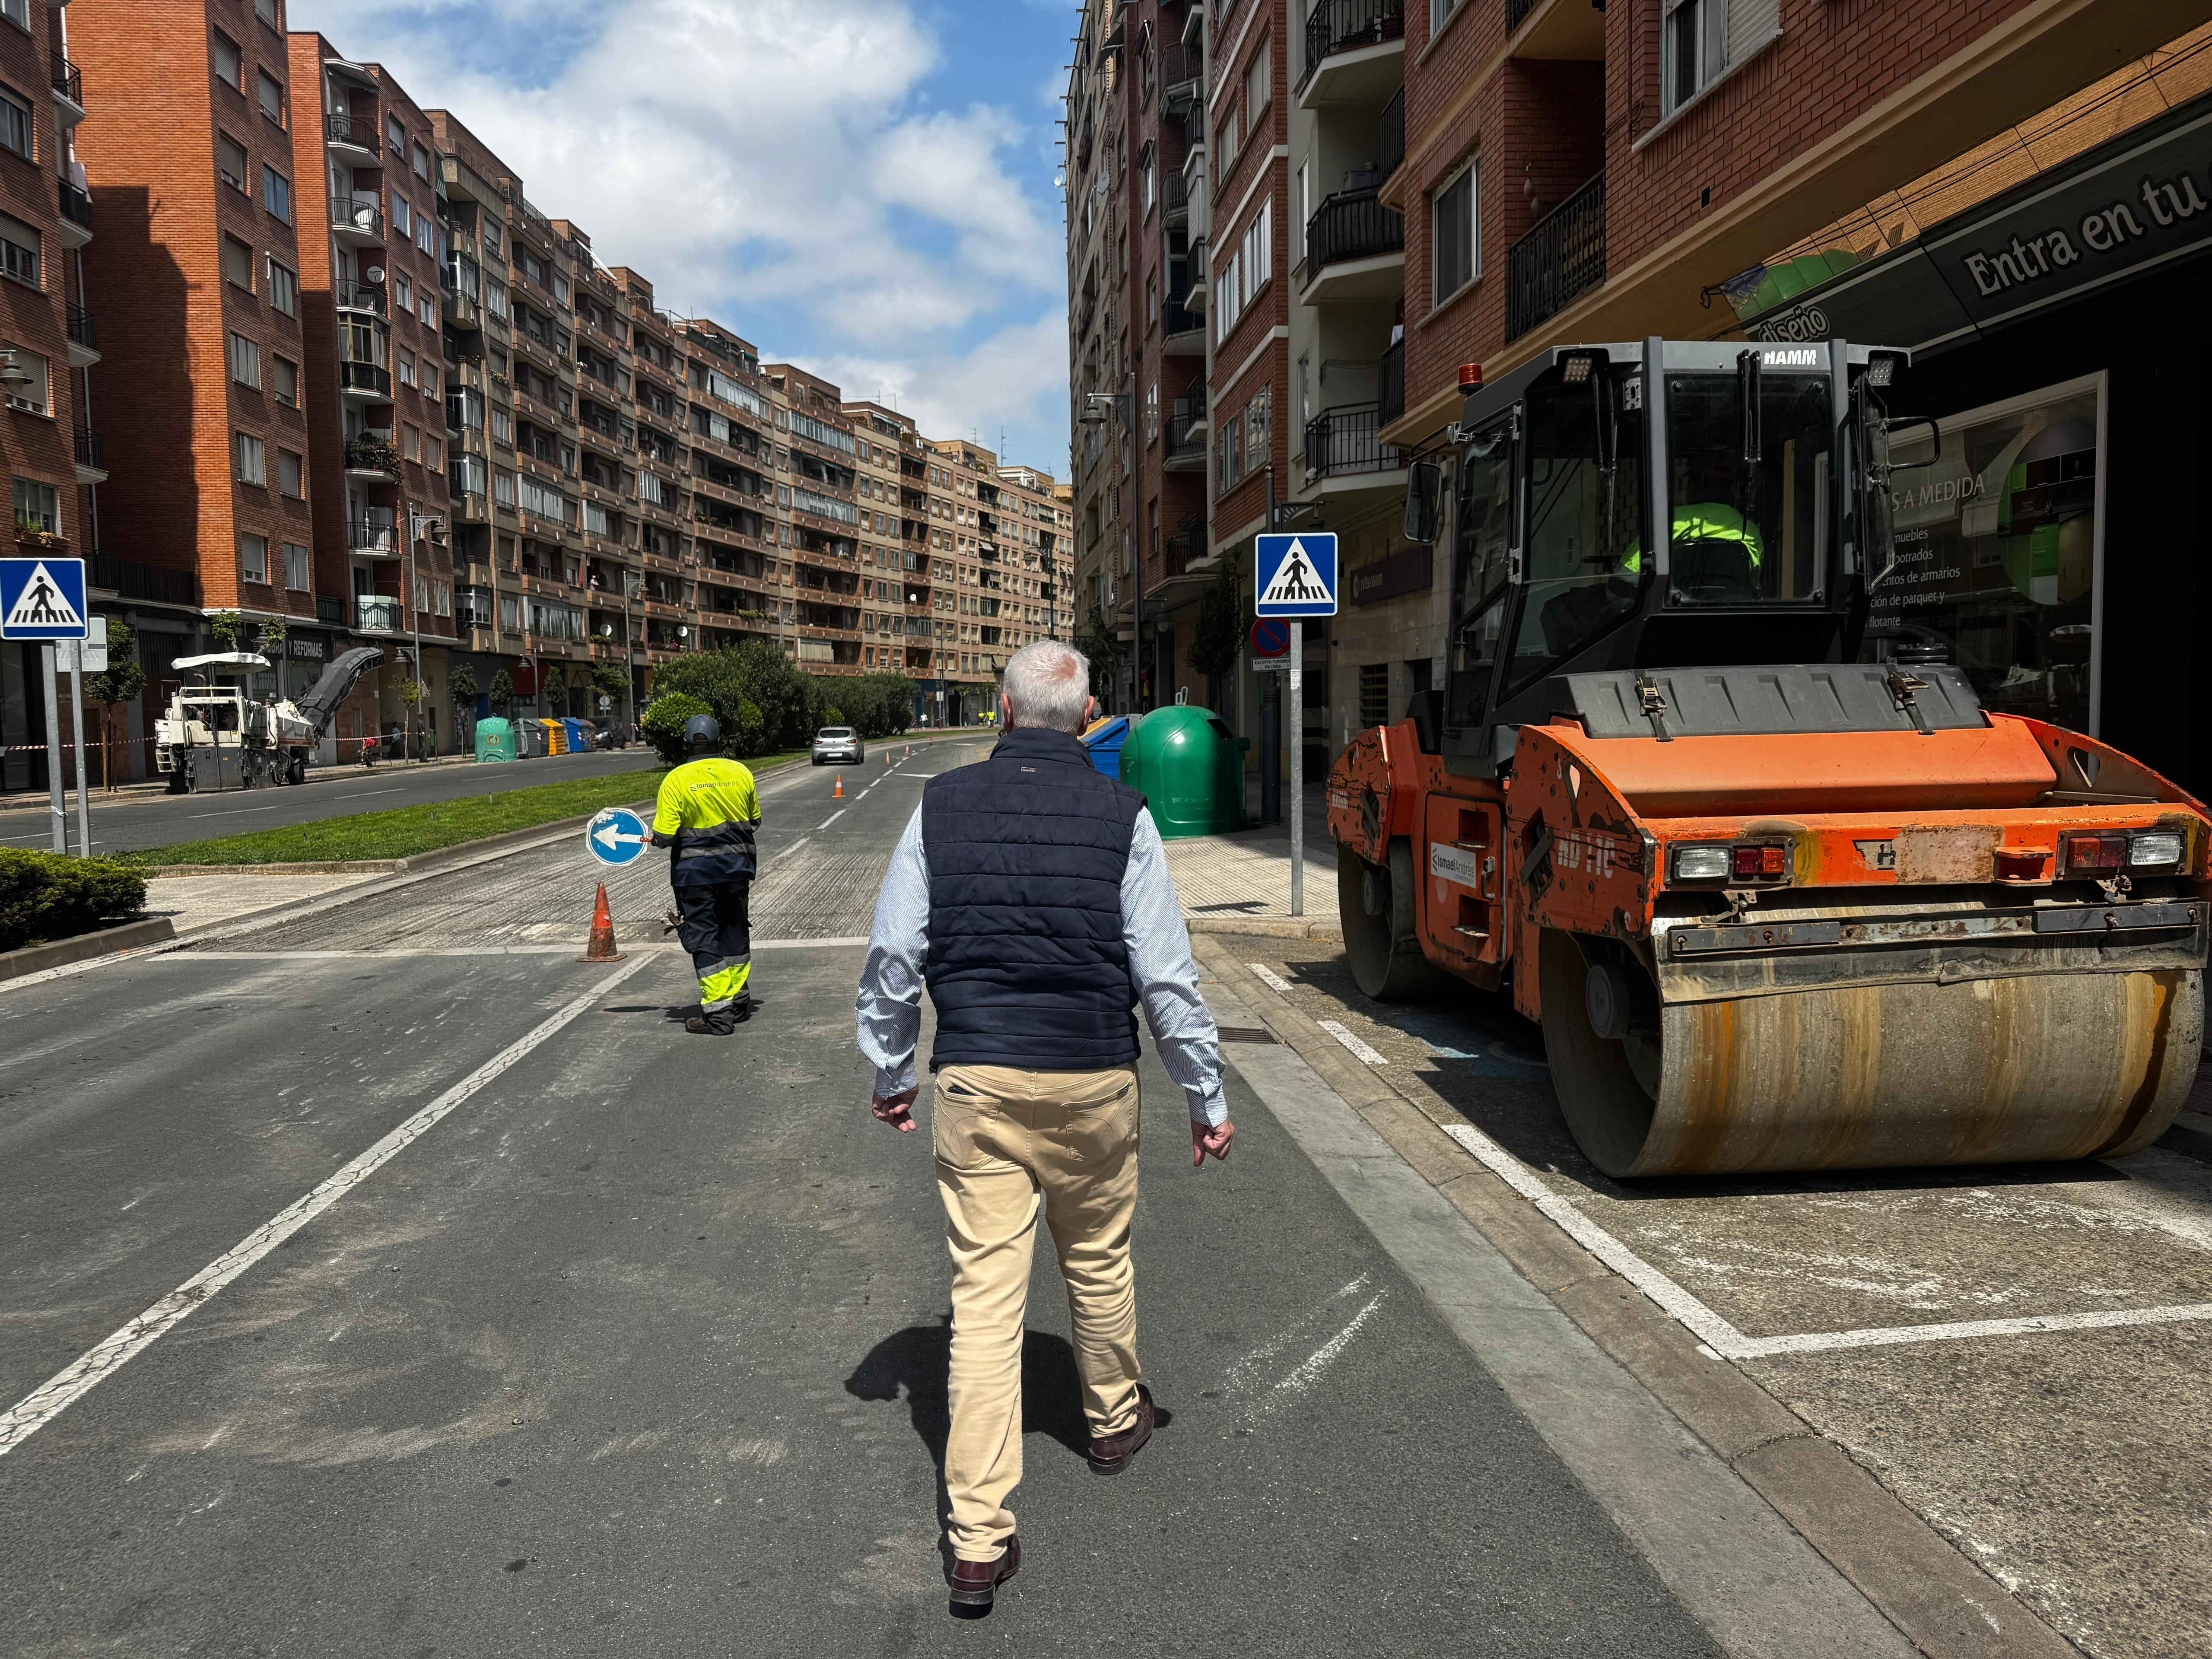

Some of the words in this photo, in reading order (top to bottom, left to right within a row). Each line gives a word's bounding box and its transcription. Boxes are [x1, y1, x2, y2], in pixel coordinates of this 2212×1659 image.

[1964, 230, 2079, 296] Entra
[2082, 203, 2143, 251] en
[2142, 176, 2207, 226] tu
[1761, 307, 1827, 342] diseño
[1764, 350, 1817, 365] HAMM
[1903, 489, 1915, 509] A
[1918, 474, 1985, 507] MEDIDA
[1907, 571, 1919, 584] de
[1920, 566, 1961, 581] armarios
[1890, 593, 1901, 606] de
[1902, 592, 1936, 608] parquet
[1939, 591, 1945, 604] y
[1869, 616, 1901, 628] flotante
[288, 640, 292, 655] Y
[294, 639, 322, 658] REFORMAS
